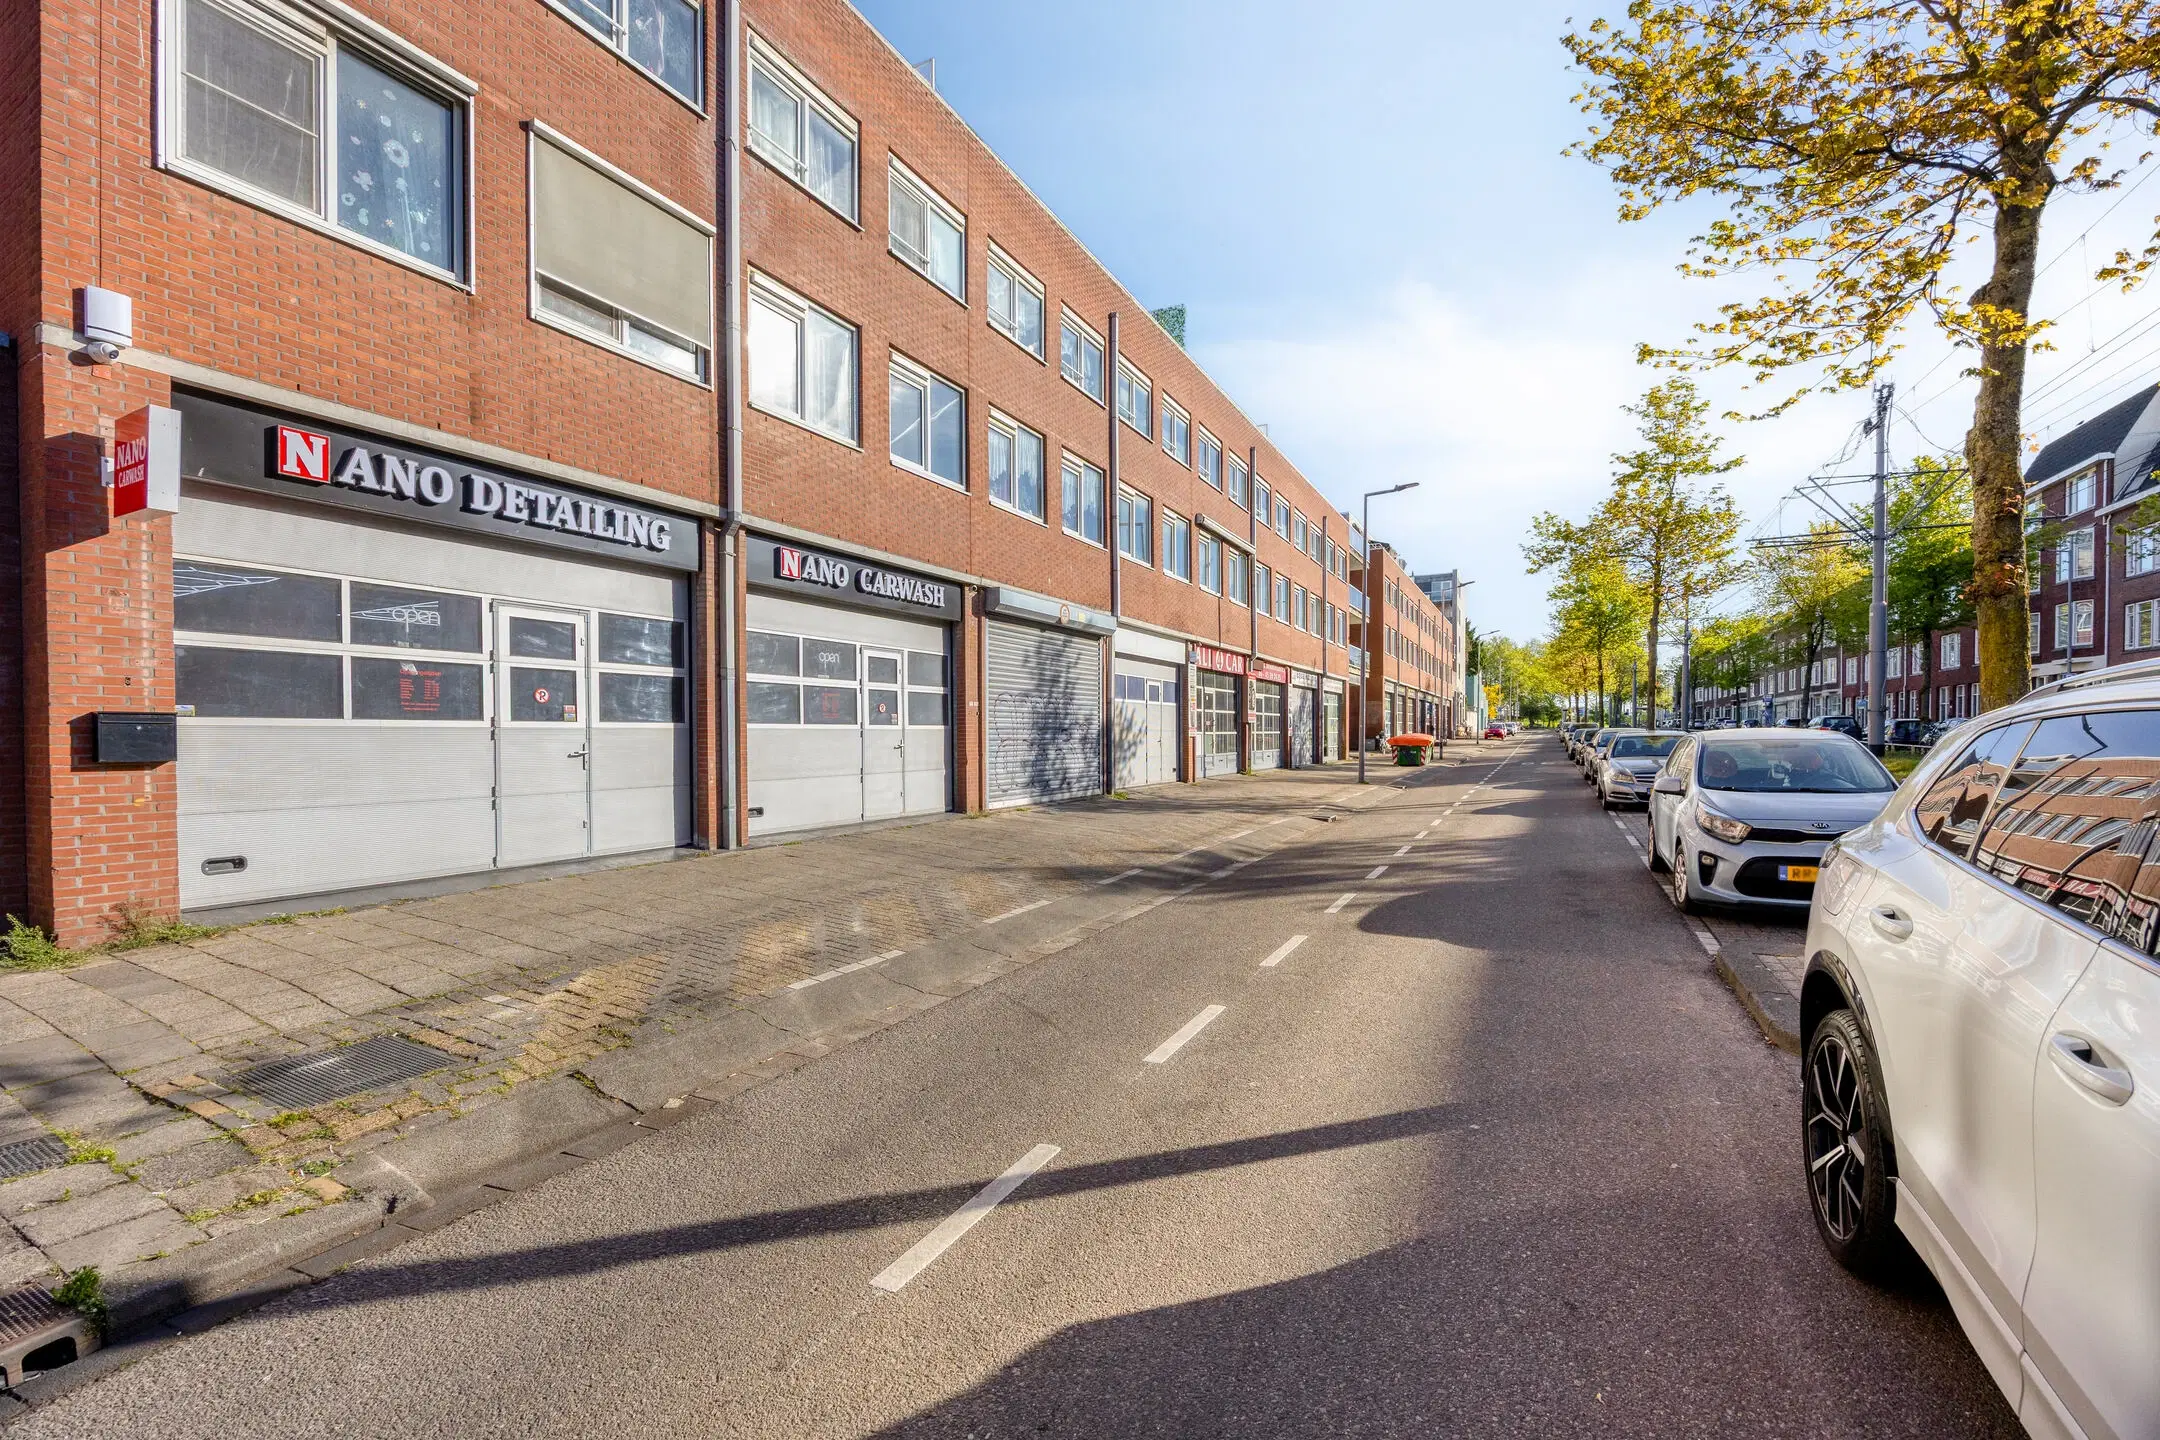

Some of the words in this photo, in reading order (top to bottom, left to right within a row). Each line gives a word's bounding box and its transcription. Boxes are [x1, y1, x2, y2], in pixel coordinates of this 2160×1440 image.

[117, 436, 147, 470] NANO
[118, 464, 145, 489] CARWASH
[282, 430, 454, 504] NANO
[470, 474, 672, 551] DETAILING
[782, 549, 849, 588] NANO
[860, 568, 946, 607] CARWASH
[392, 608, 441, 632] open
[818, 651, 840, 669] open
[1195, 646, 1212, 668] ALI
[1225, 653, 1243, 673] CAR
